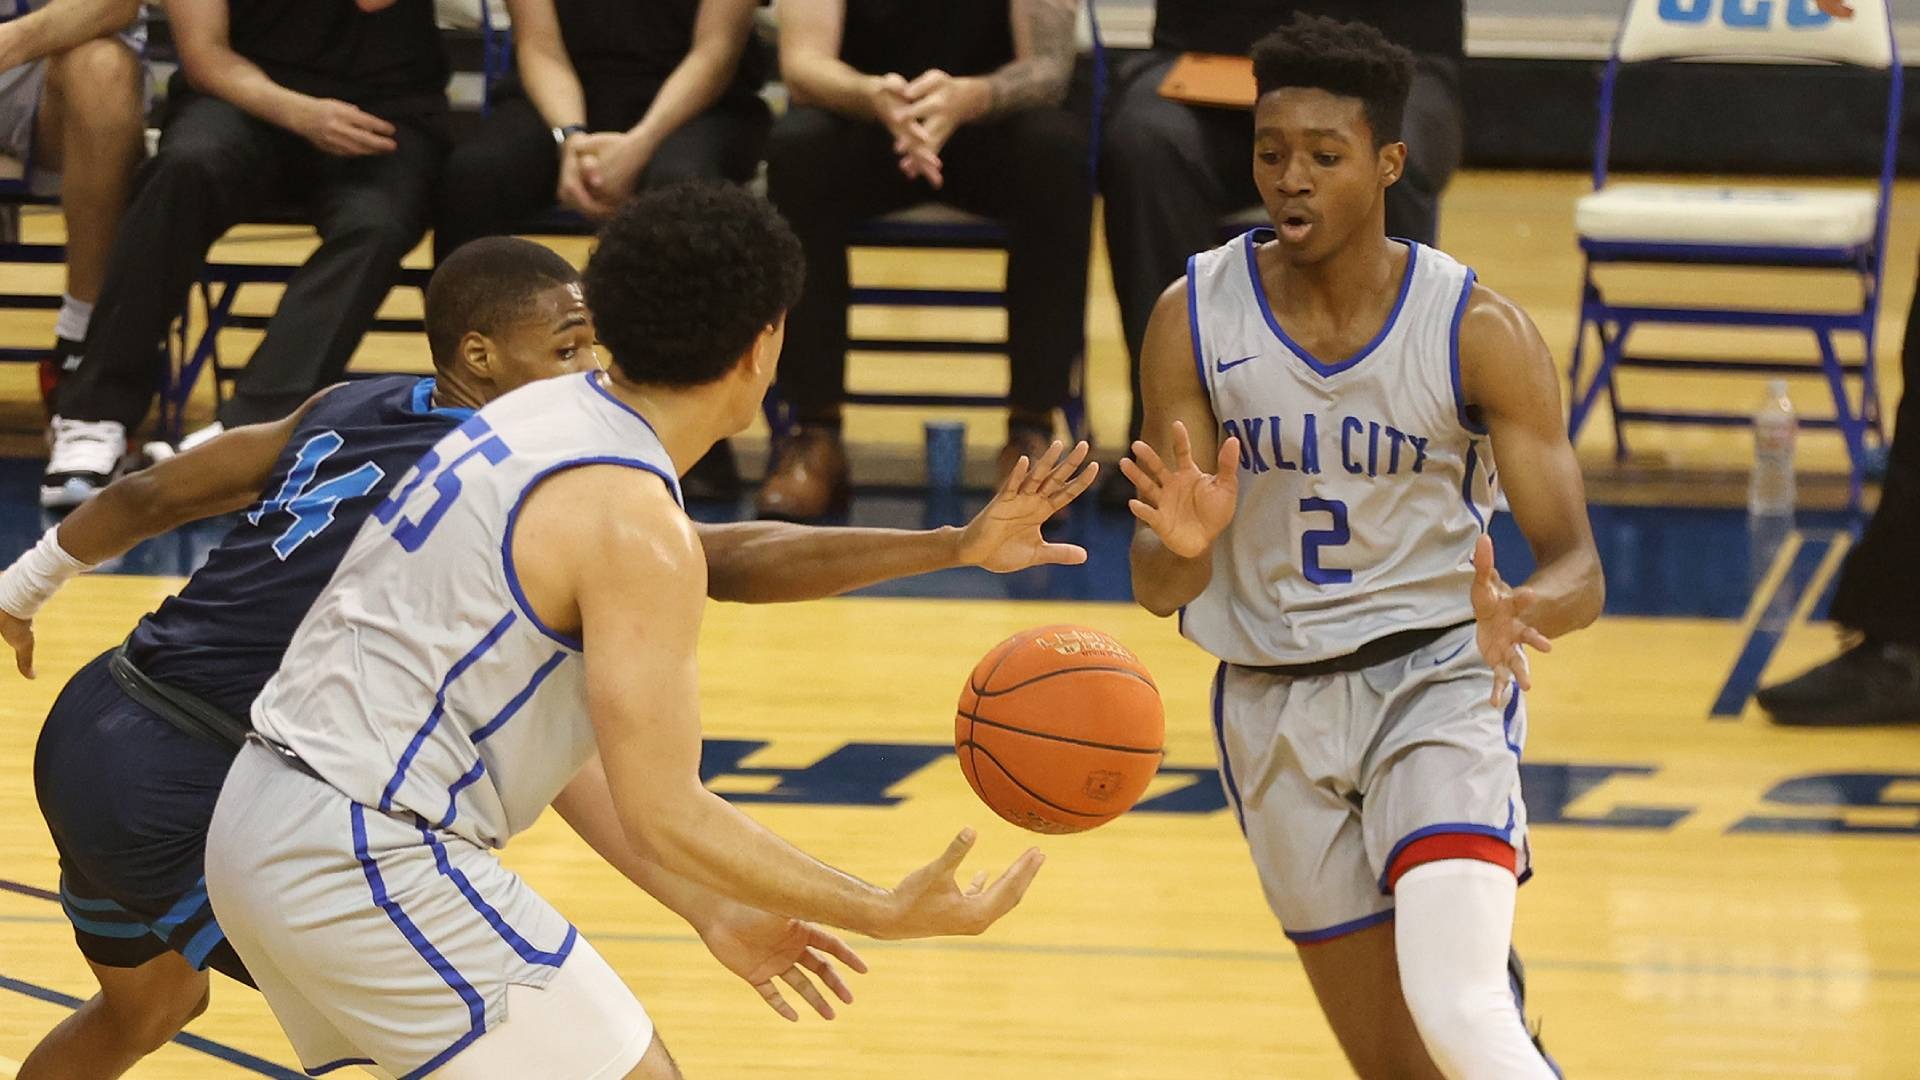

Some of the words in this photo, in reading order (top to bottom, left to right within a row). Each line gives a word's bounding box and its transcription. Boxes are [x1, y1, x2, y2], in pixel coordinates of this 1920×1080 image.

[1341, 415, 1428, 477] CITY
[247, 430, 386, 561] 14
[1299, 496, 1353, 585] 2
